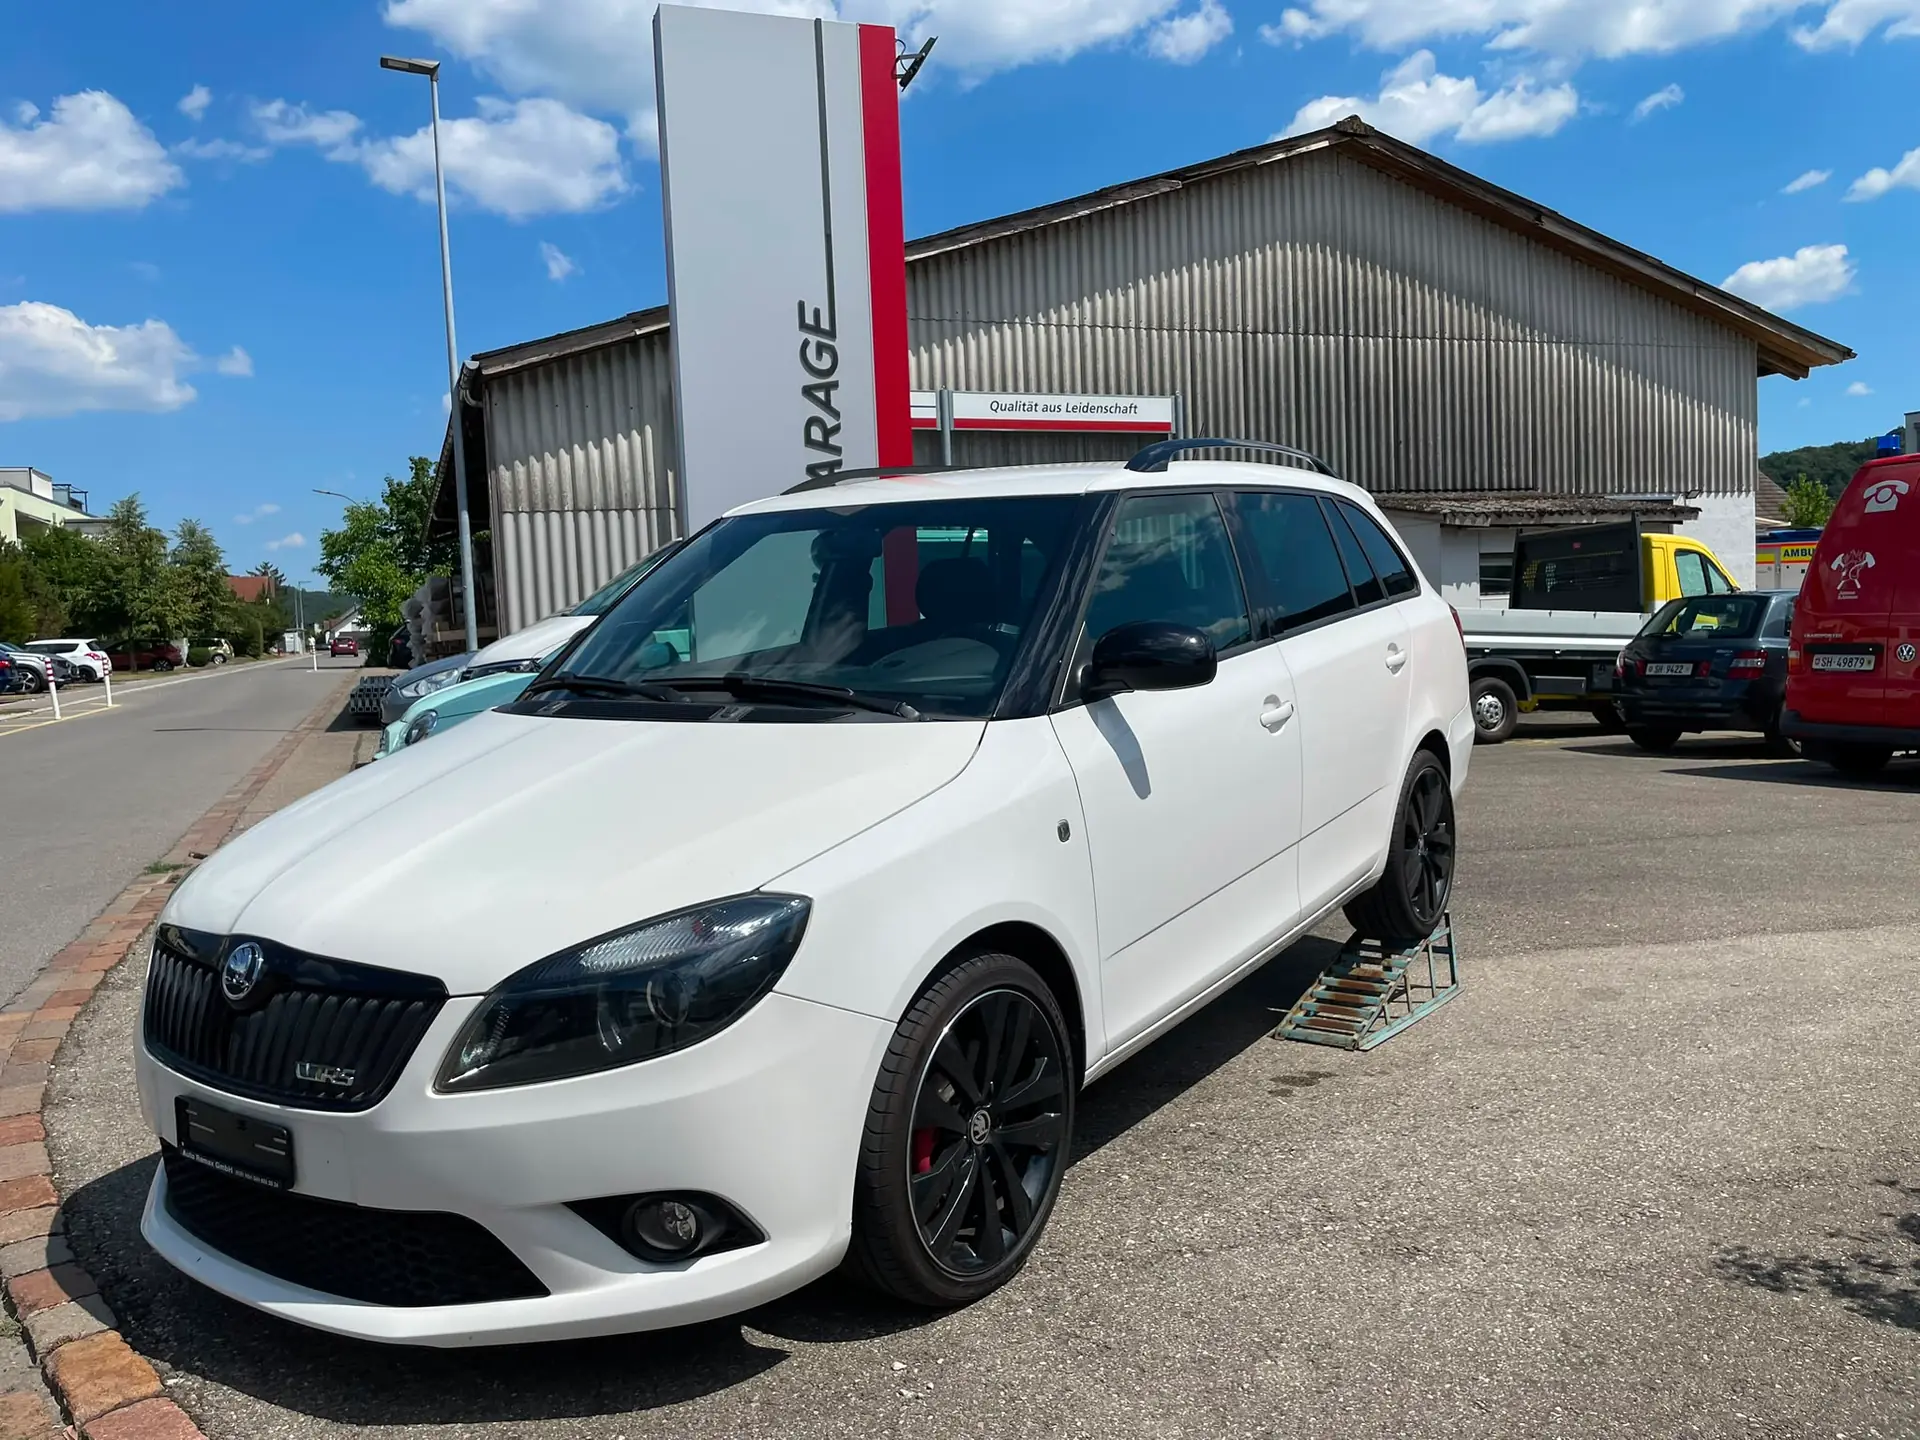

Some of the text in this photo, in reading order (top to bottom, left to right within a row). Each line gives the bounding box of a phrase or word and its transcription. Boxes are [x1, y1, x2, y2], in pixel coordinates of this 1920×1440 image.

[989, 400, 1138, 415] Qualität aus Leidenschaft
